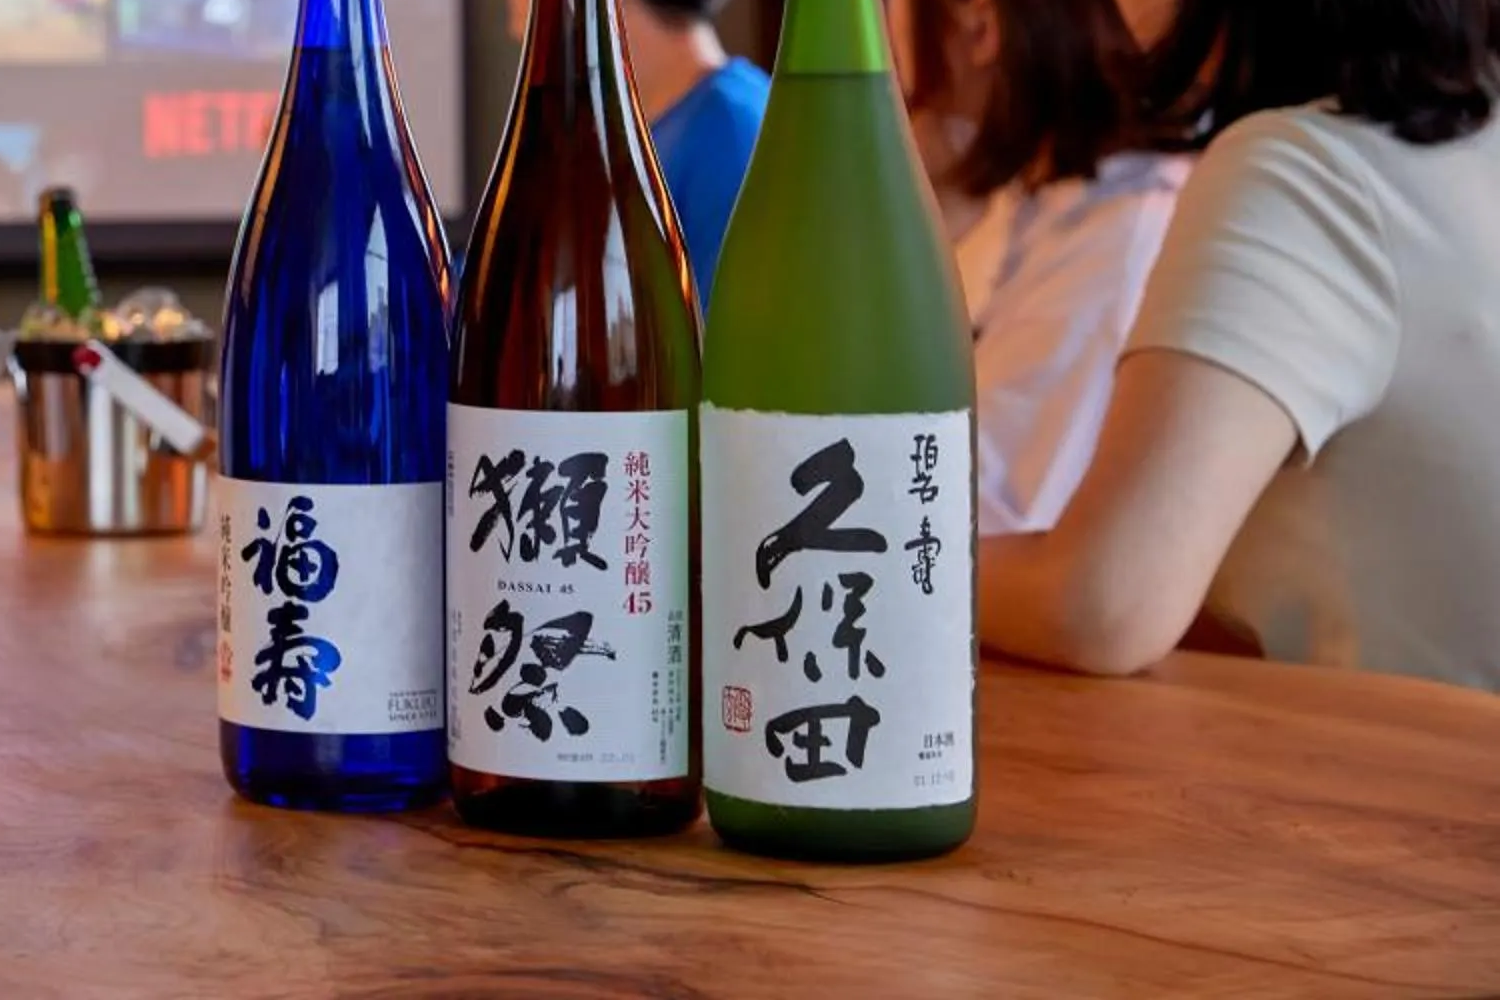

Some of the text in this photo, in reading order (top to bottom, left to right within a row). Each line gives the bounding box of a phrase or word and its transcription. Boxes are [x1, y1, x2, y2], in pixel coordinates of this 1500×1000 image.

[145, 88, 282, 157] NETF
[241, 496, 342, 721] 福寿
[498, 580, 575, 594] DASSAI 45
[733, 438, 888, 783] 久保田
